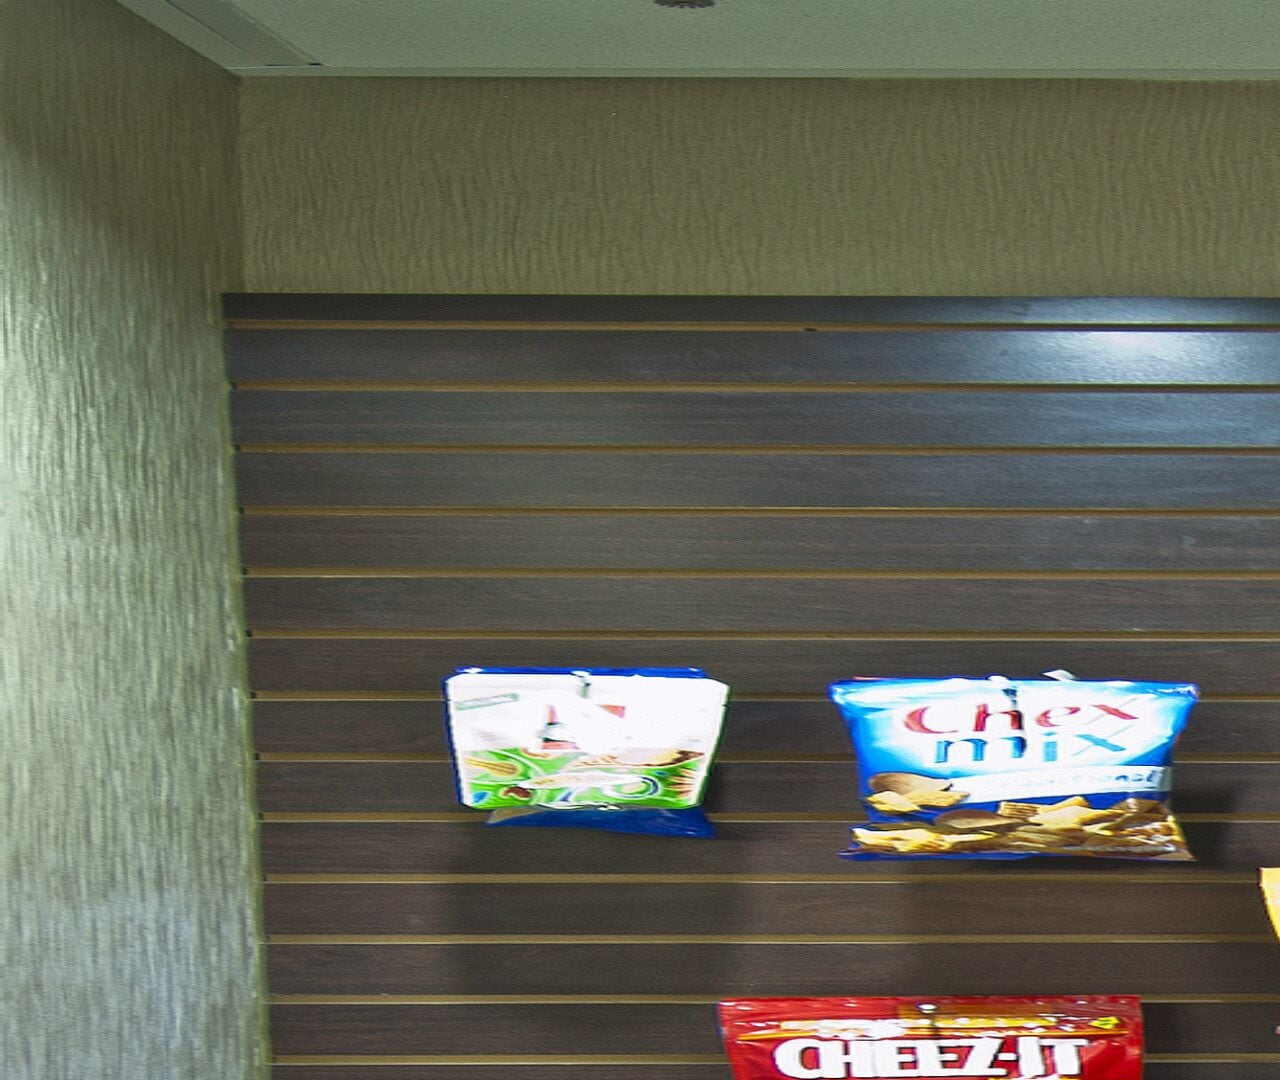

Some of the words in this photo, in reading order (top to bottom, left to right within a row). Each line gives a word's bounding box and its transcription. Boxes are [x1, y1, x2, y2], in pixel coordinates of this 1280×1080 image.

[903, 699, 1139, 734] Chex
[933, 727, 1131, 764] mix
[773, 1036, 1090, 1080] CHEEZ-IT
